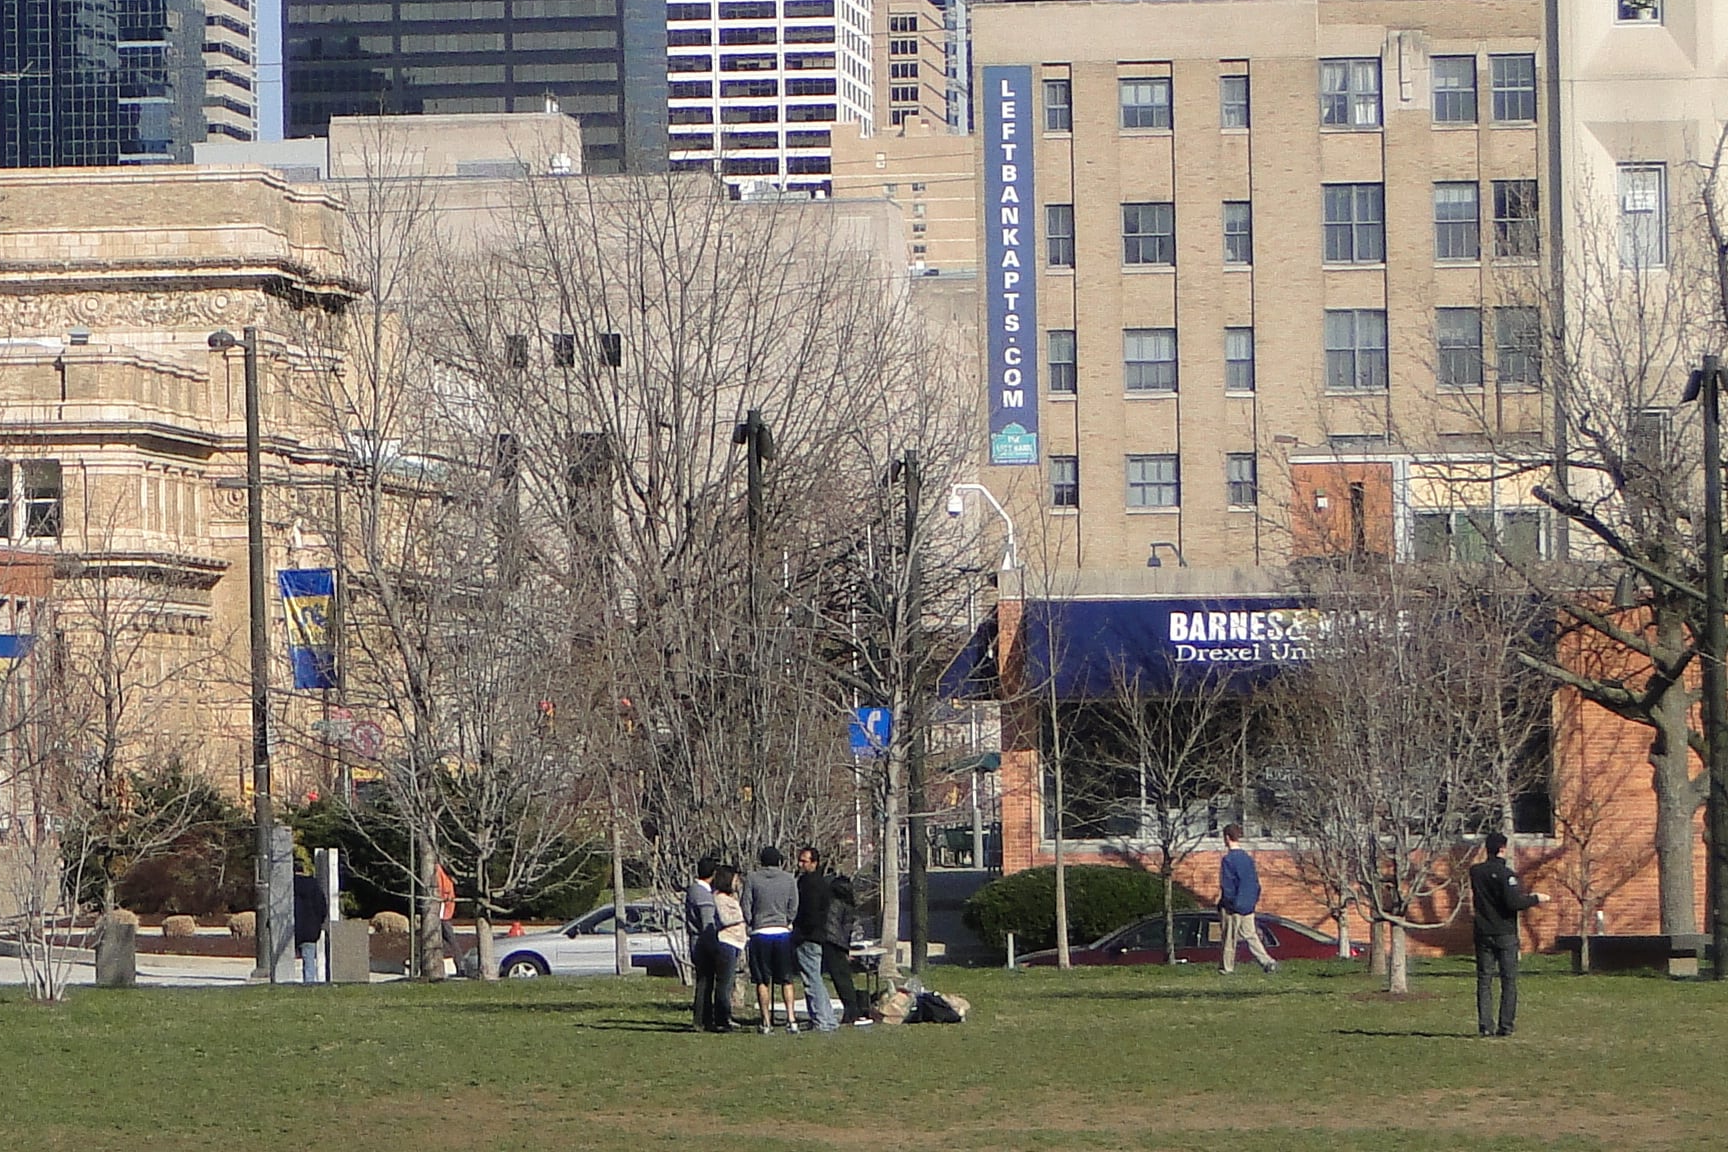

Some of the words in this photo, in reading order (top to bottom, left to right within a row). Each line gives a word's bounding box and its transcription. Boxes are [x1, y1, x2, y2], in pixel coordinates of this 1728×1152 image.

[1169, 611, 1284, 642] BARNES
[1285, 610, 1311, 641] &
[1175, 644, 1262, 662] Drexel
